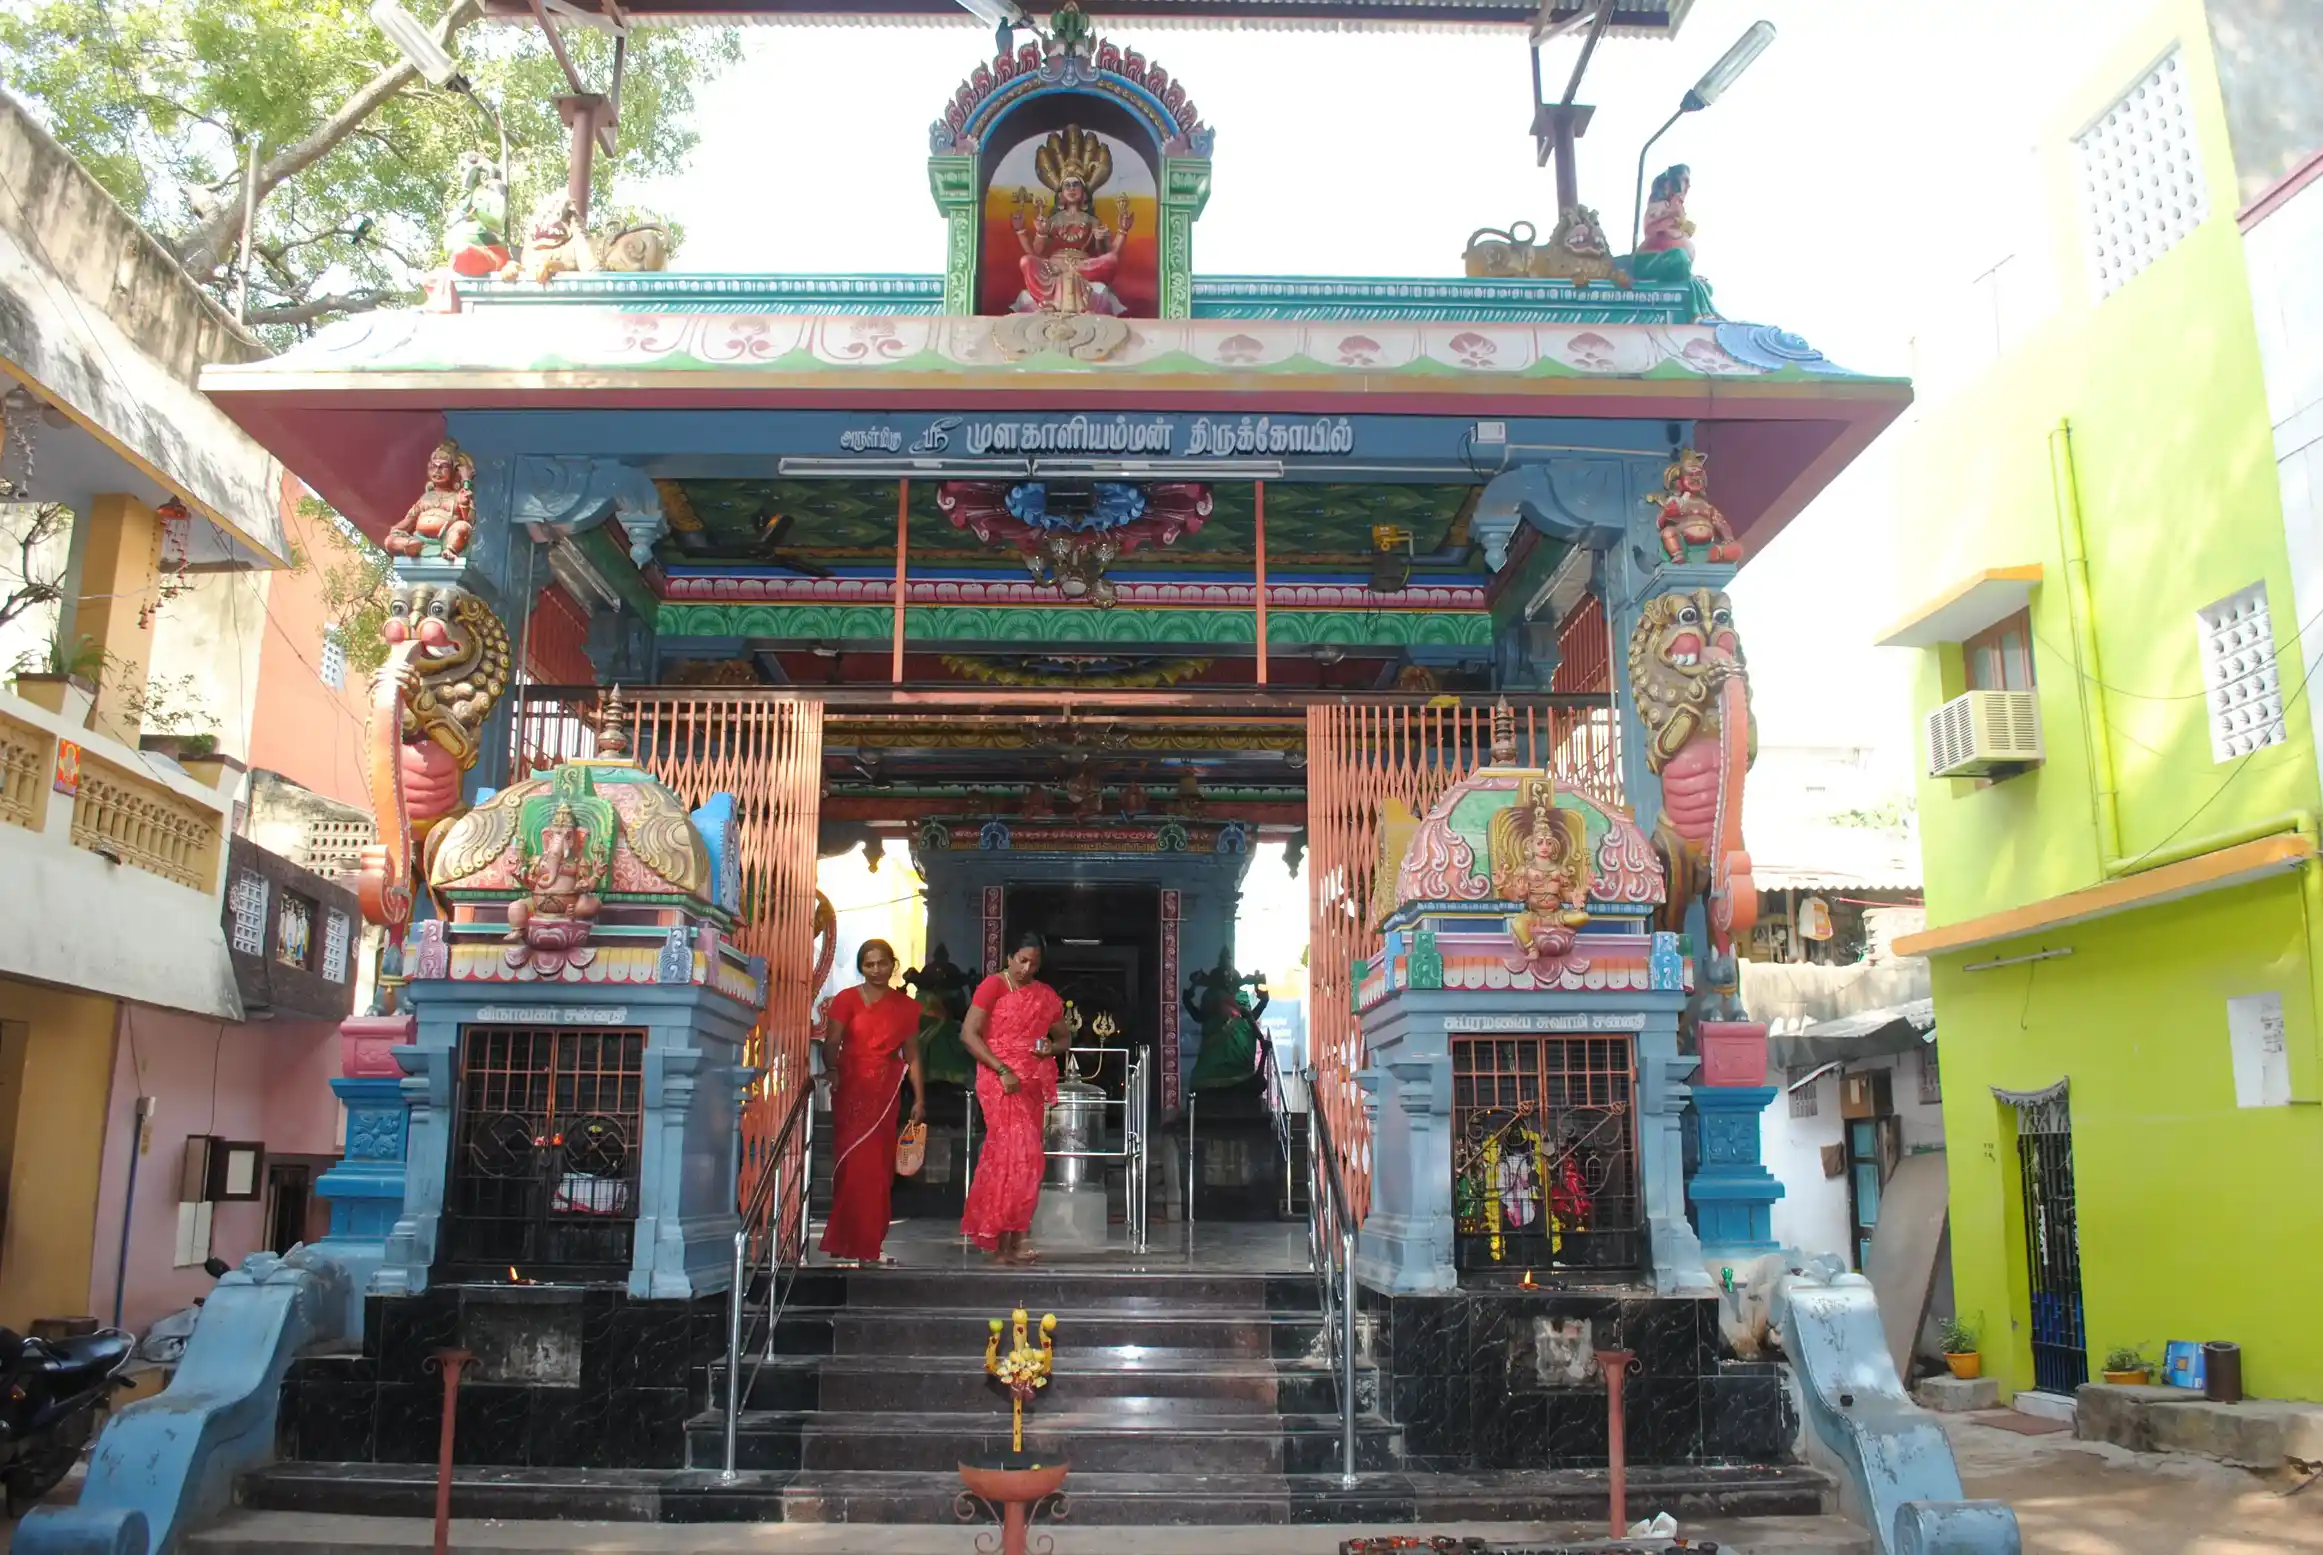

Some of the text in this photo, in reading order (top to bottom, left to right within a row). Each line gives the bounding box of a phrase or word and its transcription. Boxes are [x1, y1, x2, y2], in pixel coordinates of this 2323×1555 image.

[840, 425, 902, 452] அருள்மிகு
[908, 416, 963, 454] ஸ்ரீ
[1183, 416, 1353, 456] திருக்கோயில்
[476, 1005, 560, 1022] விநாயகர்
